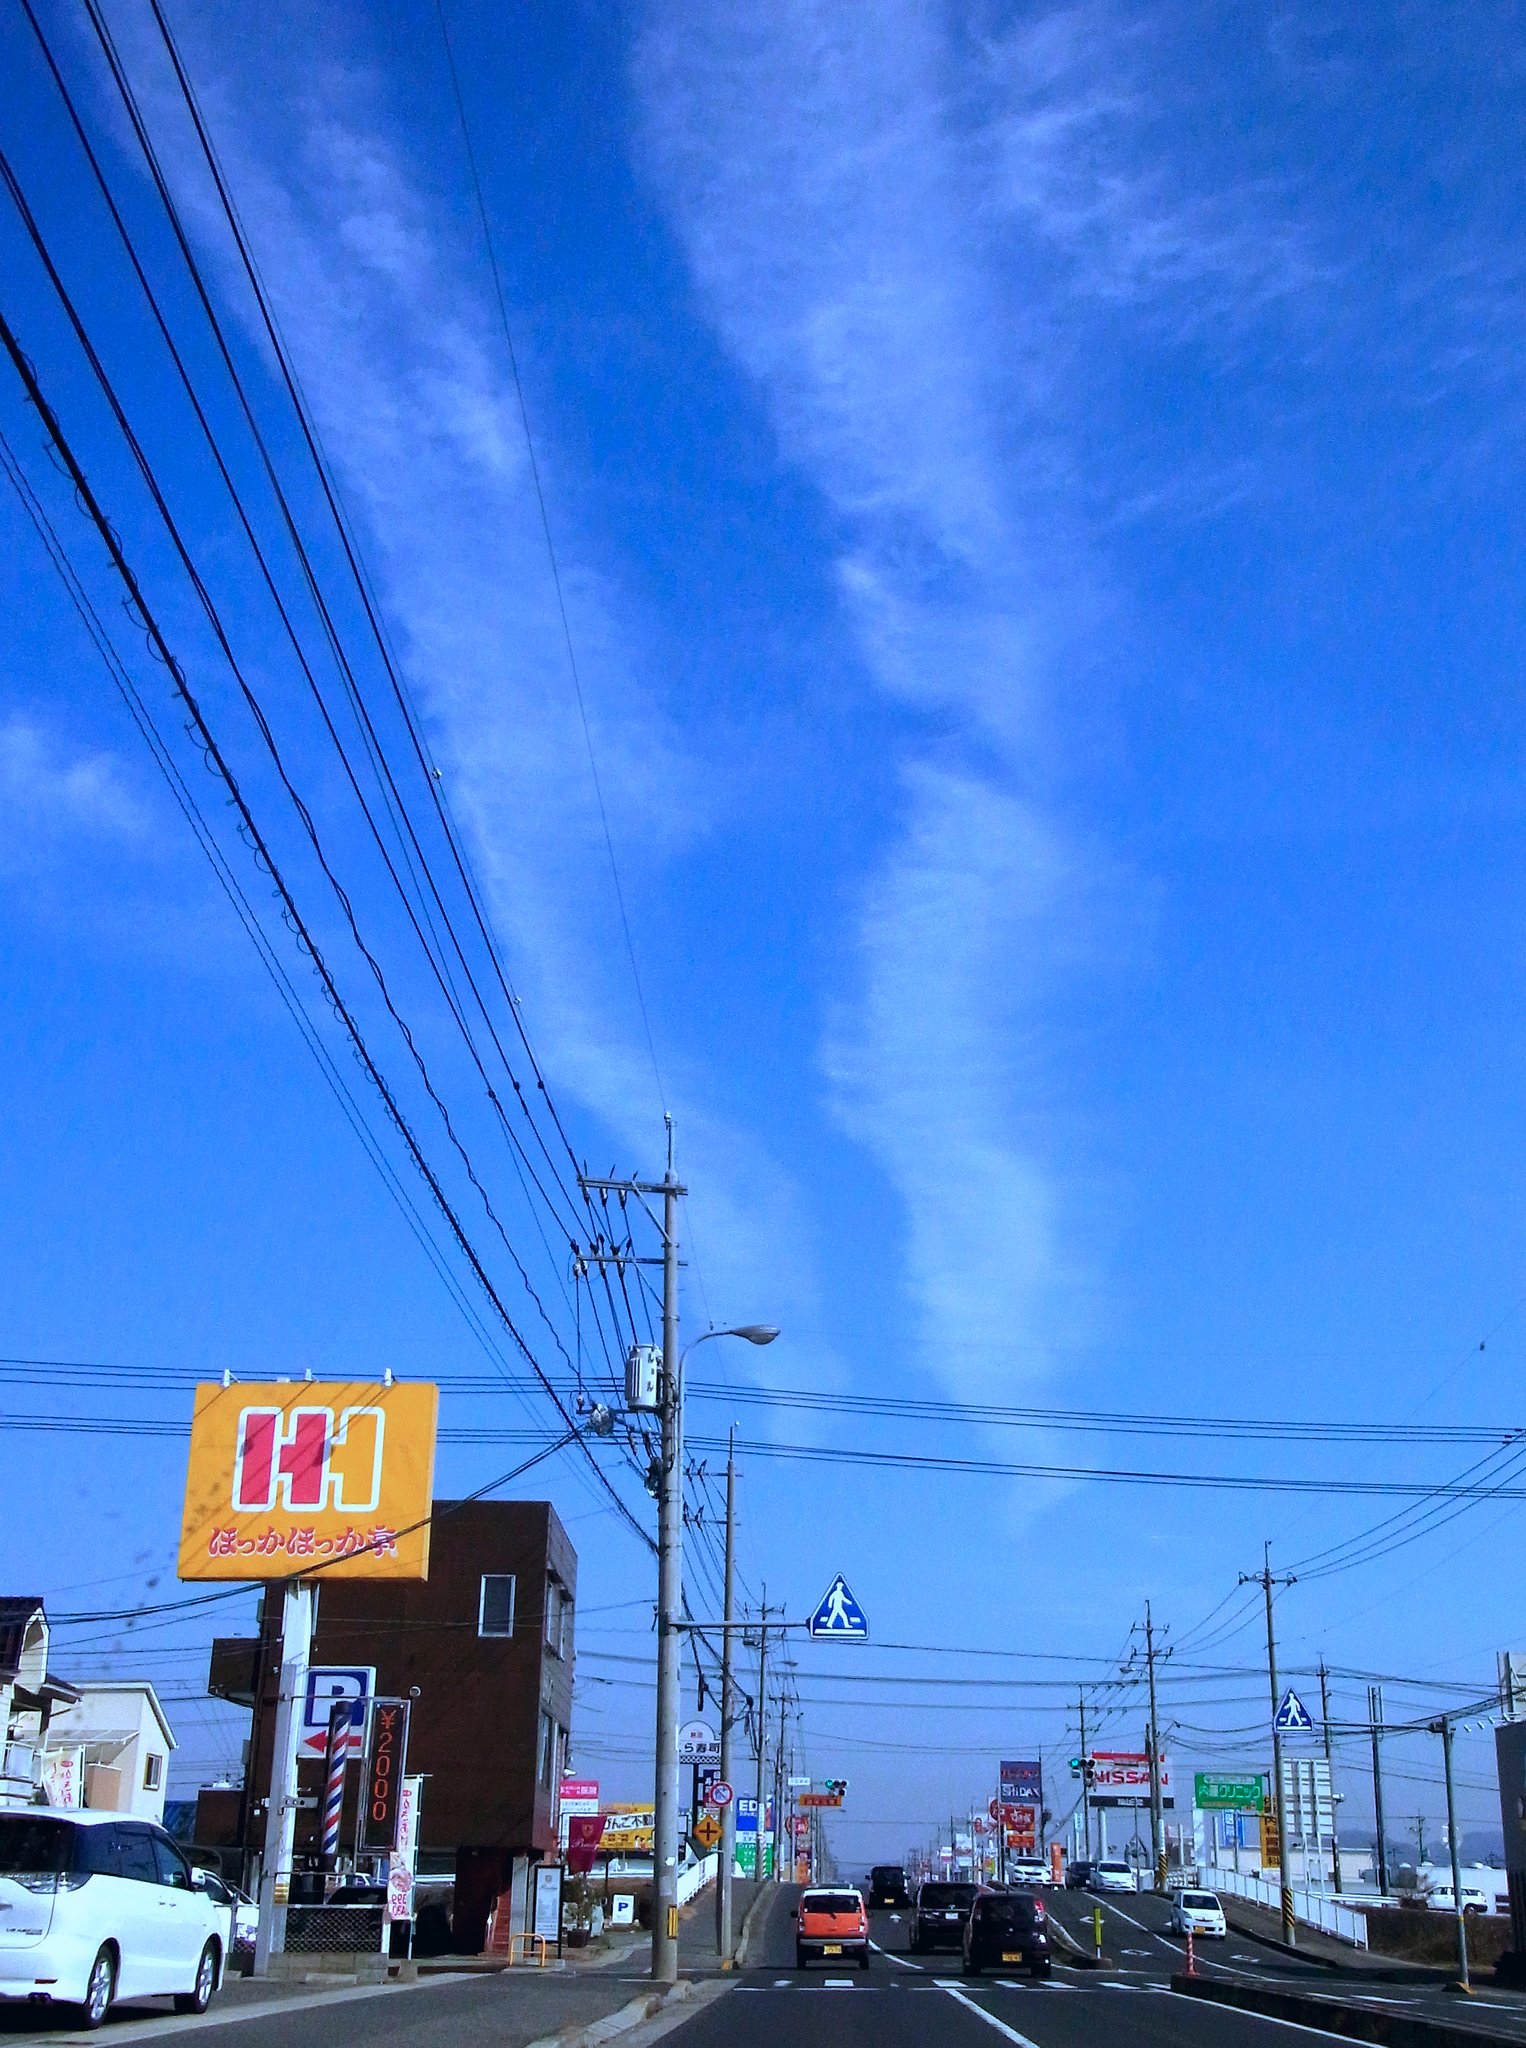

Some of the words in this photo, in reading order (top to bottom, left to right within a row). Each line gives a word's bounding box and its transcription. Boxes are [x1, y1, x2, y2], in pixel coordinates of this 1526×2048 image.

[208, 1525, 399, 1559] ほっかほっか亭
[681, 1742, 720, 1754] ら寿司
[617, 1902, 629, 1912] P
